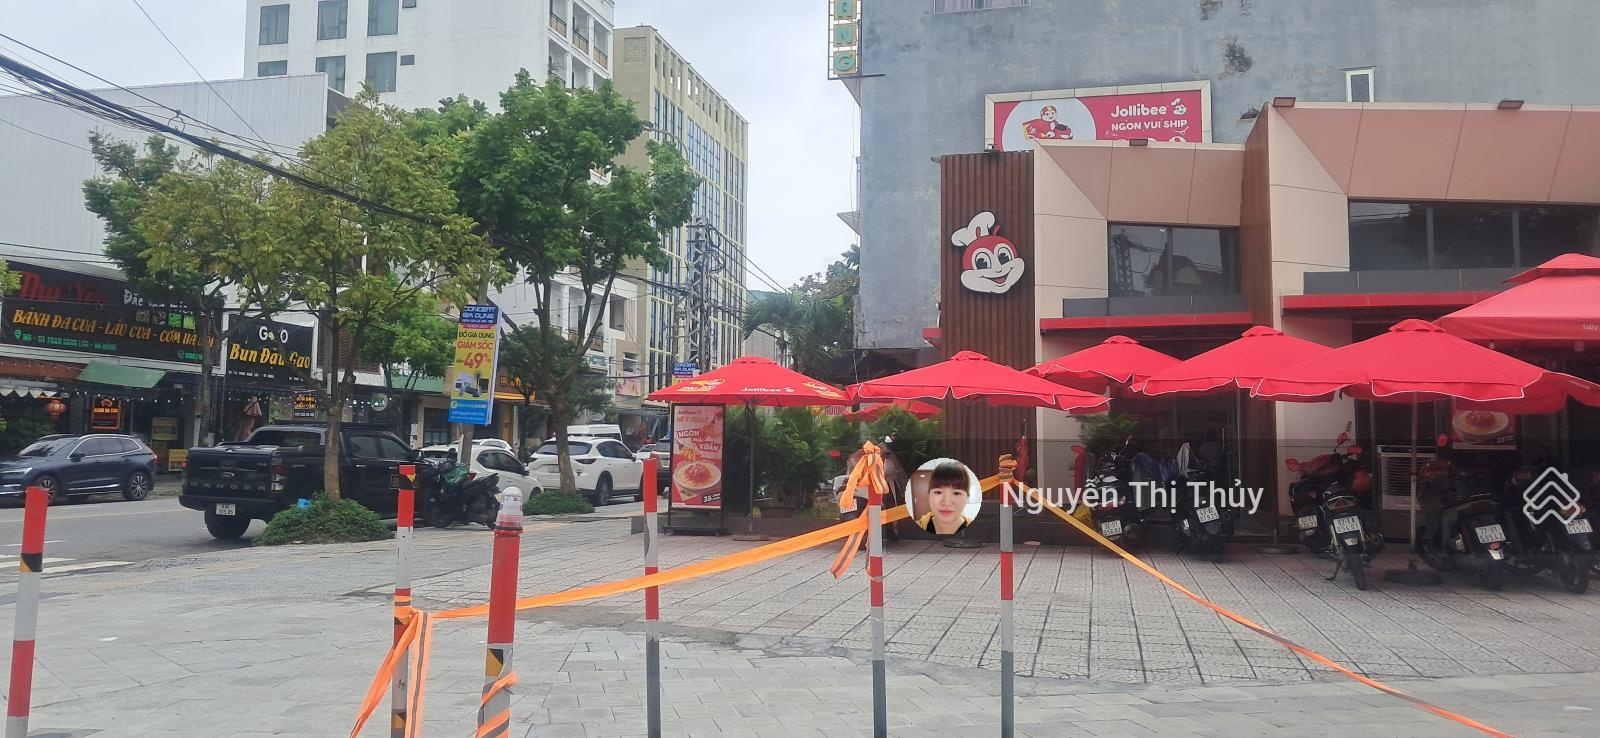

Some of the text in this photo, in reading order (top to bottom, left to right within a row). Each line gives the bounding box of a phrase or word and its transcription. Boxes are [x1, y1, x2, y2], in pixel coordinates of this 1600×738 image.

[1111, 103, 1167, 118] Jollibee
[1111, 119, 1188, 131] NGON VUI SHIP
[12, 307, 50, 327] BÁNH
[51, 314, 71, 330] ĐA
[72, 317, 97, 333] CUA
[129, 325, 152, 340] CUA
[677, 430, 700, 438] NGON
[190, 481, 266, 491] RANGER
